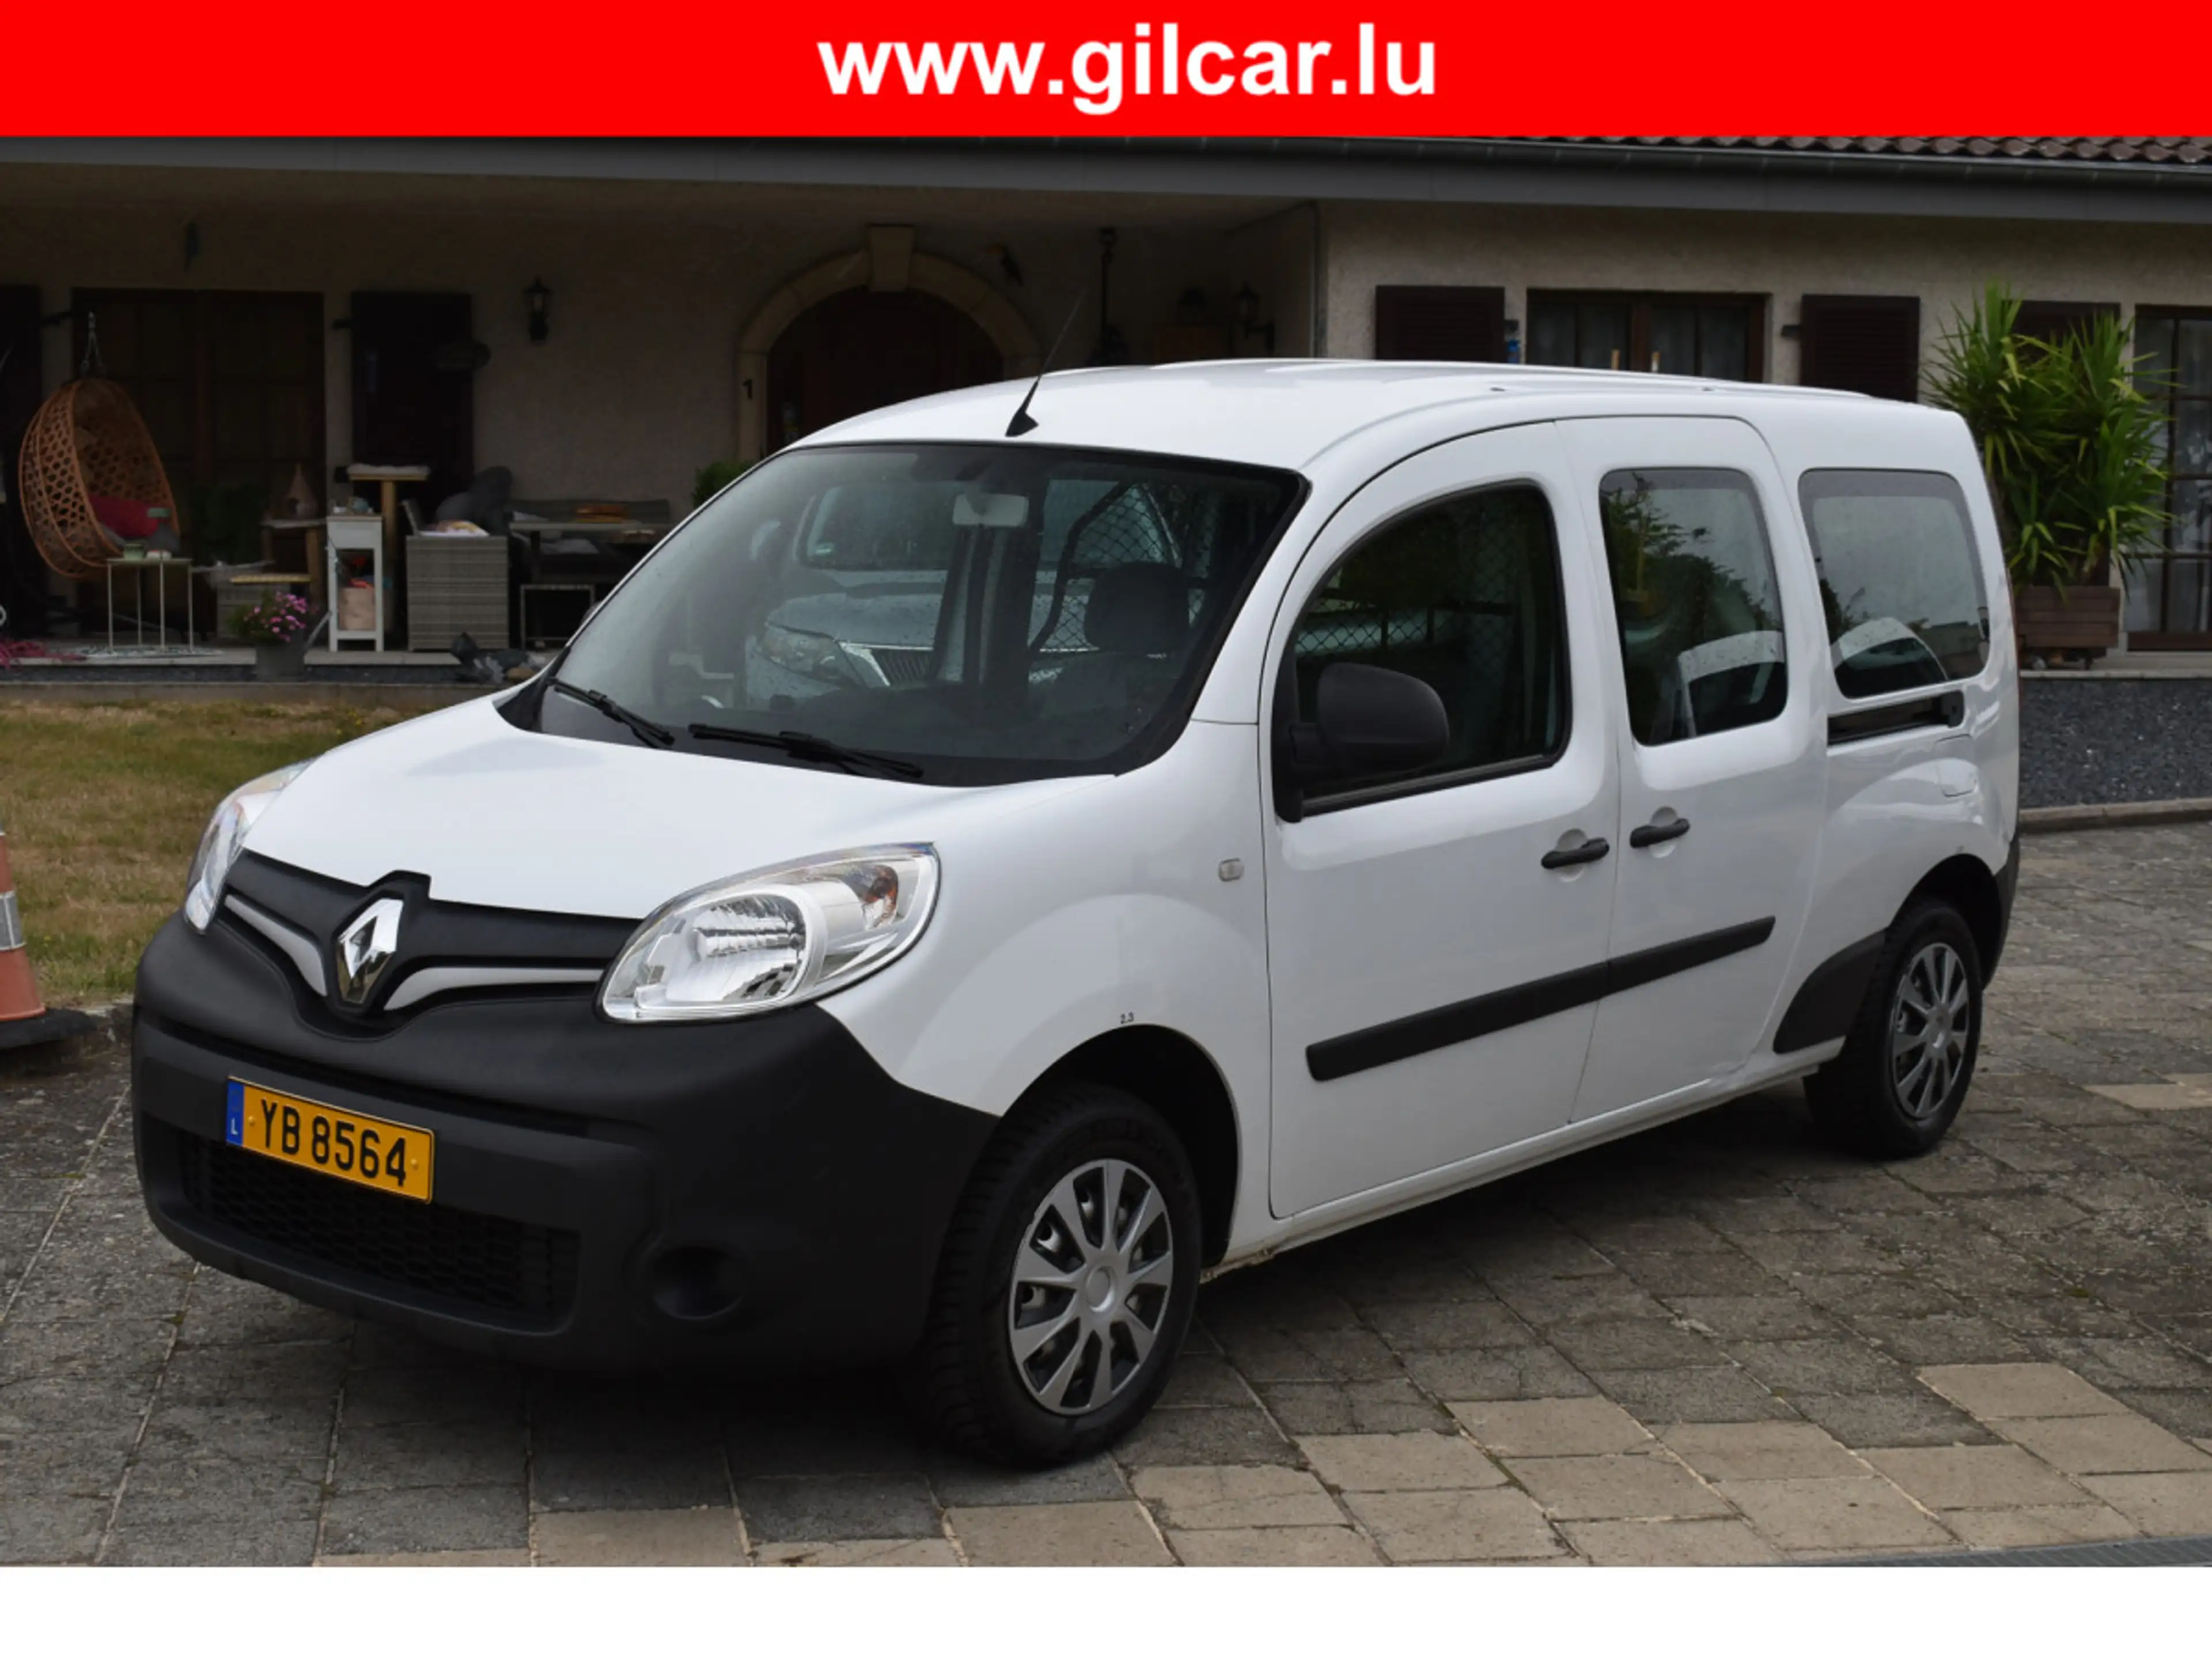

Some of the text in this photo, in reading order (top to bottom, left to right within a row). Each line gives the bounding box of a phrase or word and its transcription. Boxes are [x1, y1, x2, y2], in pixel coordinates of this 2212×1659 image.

[743, 378, 753, 400] 1
[231, 1118, 238, 1135] L
[261, 1097, 407, 1187] YB 8564
